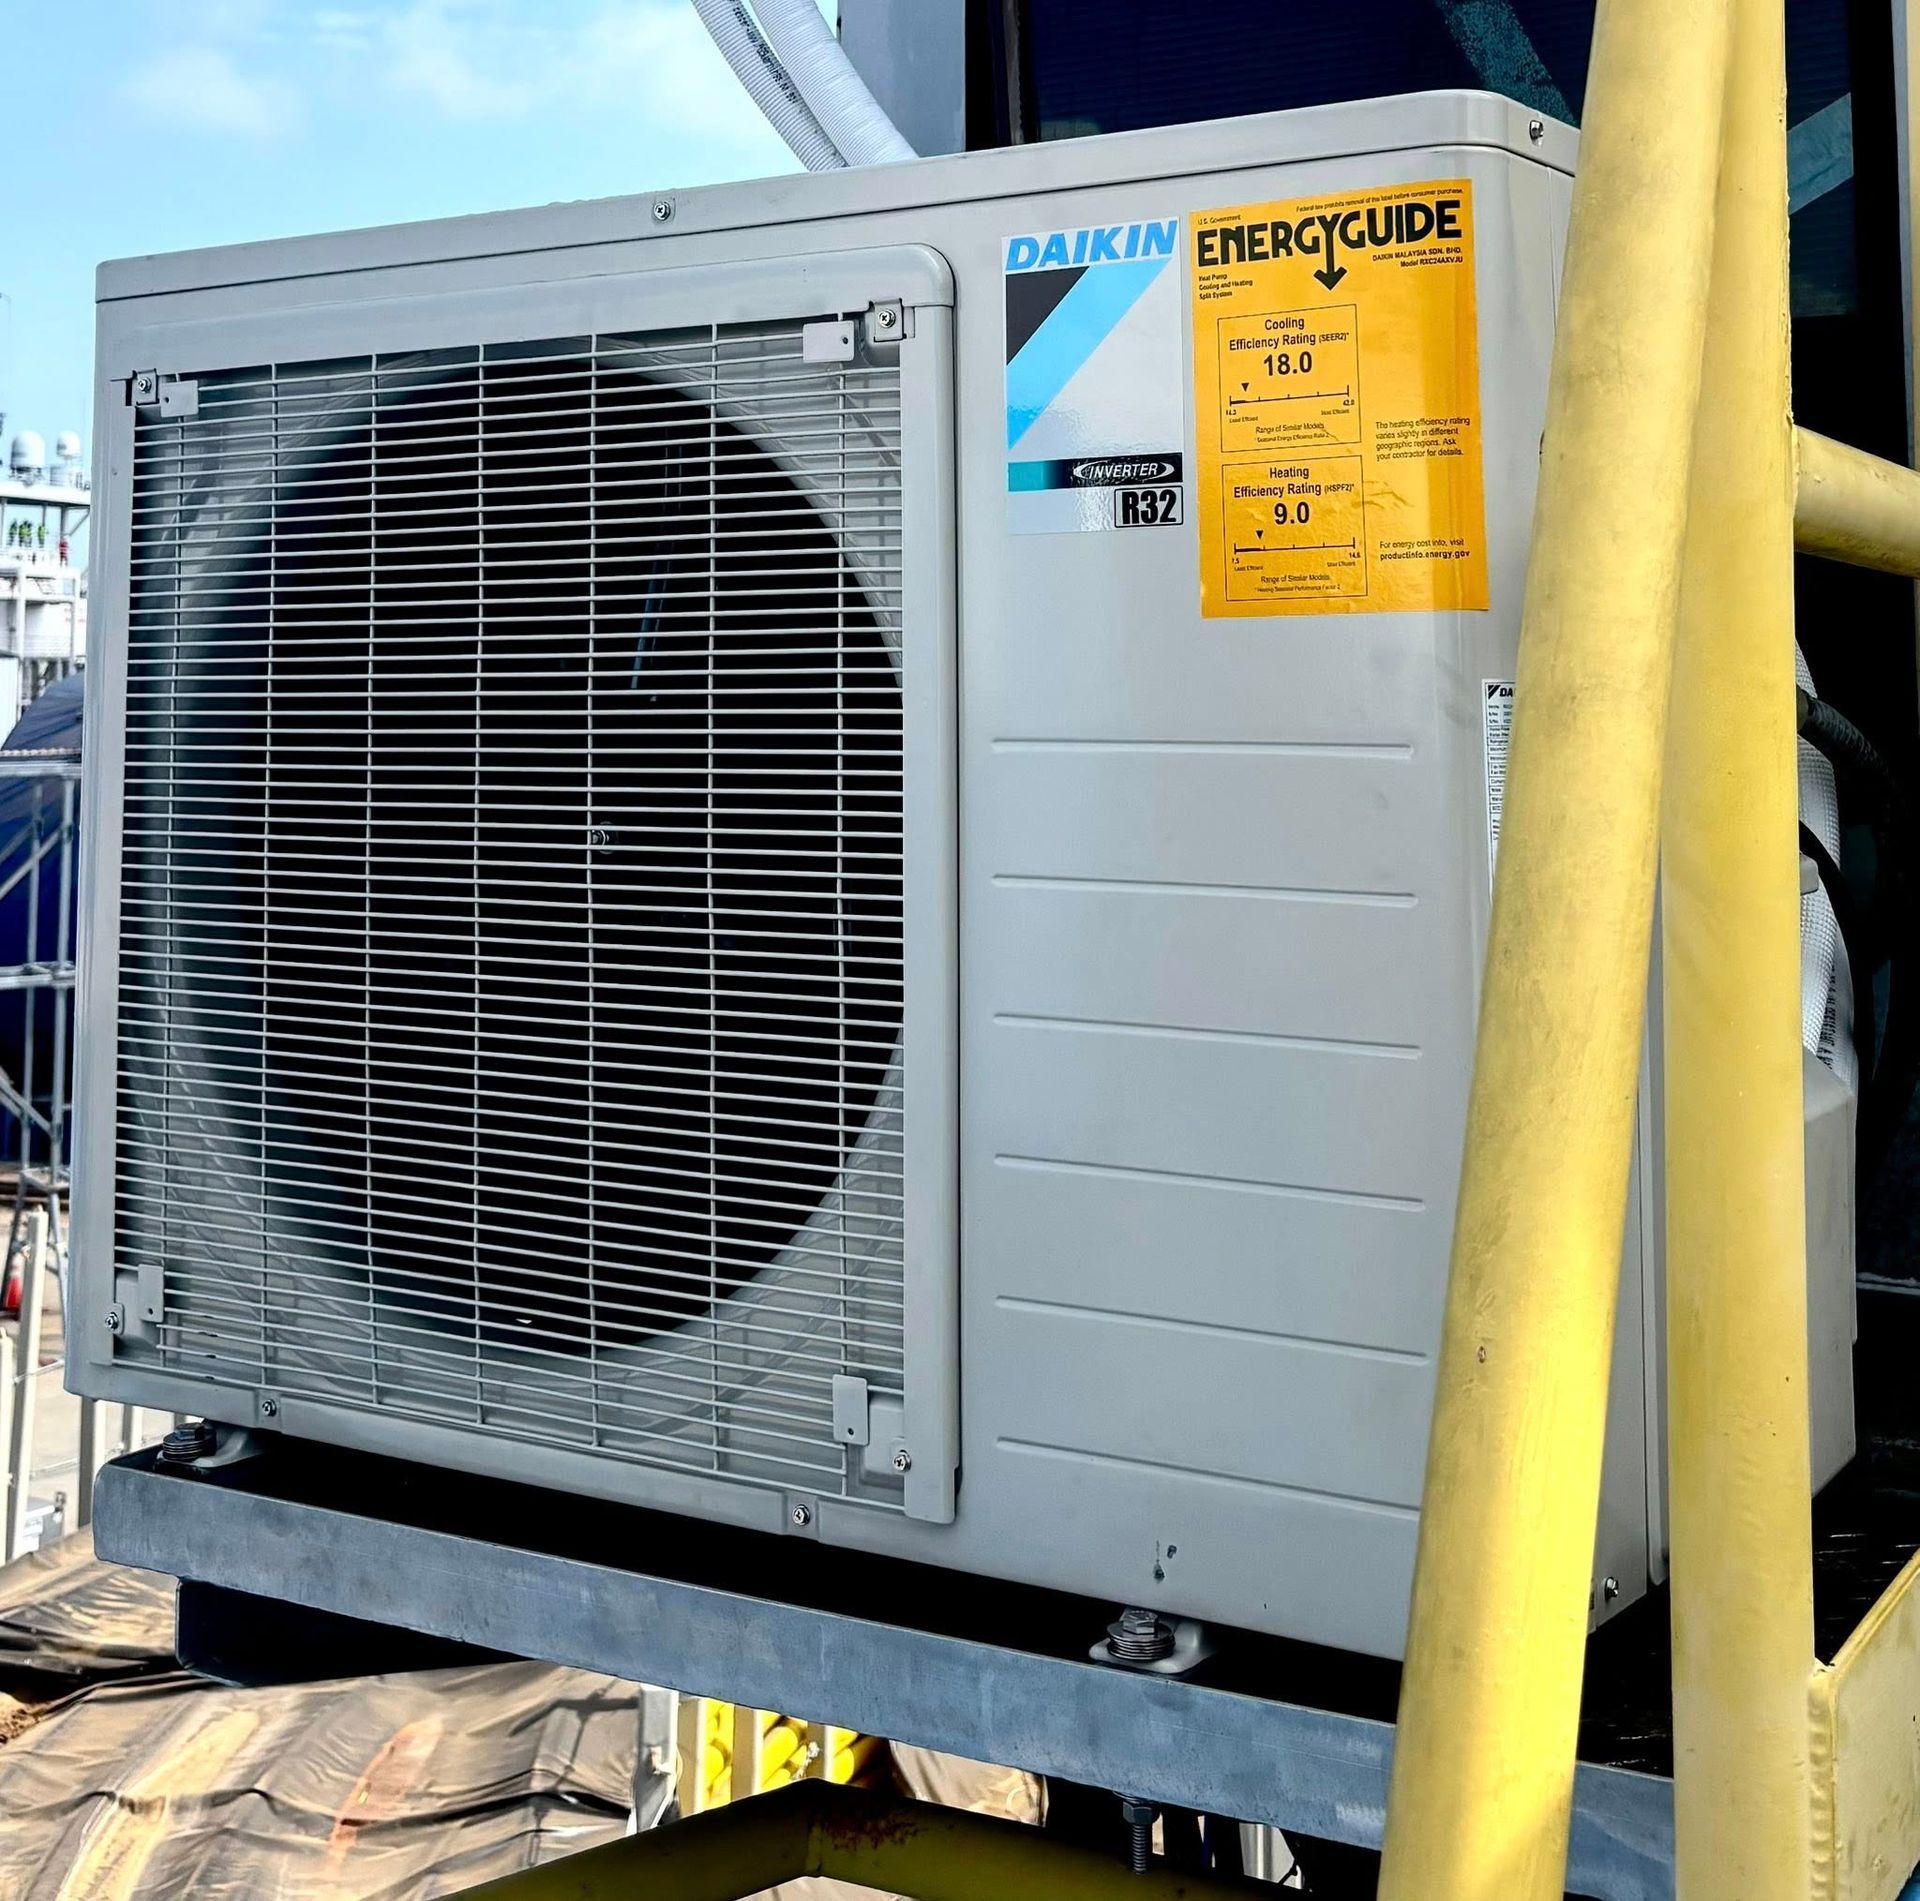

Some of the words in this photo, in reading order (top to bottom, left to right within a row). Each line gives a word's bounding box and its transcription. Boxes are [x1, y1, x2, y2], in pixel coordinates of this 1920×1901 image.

[1006, 219, 1178, 271] DAIKIN
[1372, 252, 1394, 261] DAIKIN
[1394, 249, 1428, 259] MALAYSIA
[1428, 247, 1444, 255] SDN.
[1400, 258, 1418, 267] Model
[1264, 317, 1305, 331] Cooling
[1229, 337, 1279, 351] Efficiency
[1282, 333, 1316, 346] Rating
[1263, 351, 1313, 376] 18.0
[1255, 426, 1274, 434] Range
[1375, 421, 1388, 429] The
[1389, 420, 1414, 430] heating
[1415, 418, 1448, 427] efficiency
[1449, 417, 1471, 426] rating
[1375, 432, 1395, 440] varies
[1397, 429, 1420, 439] slightly
[1421, 429, 1428, 437] in
[1428, 427, 1459, 436] different
[1376, 440, 1413, 452] geographic
[1413, 438, 1441, 448] regions.
[1442, 437, 1457, 446] Ask
[1376, 453, 1391, 462] your
[1392, 450, 1426, 459] contractor
[1426, 449, 1436, 457] for
[1437, 448, 1464, 456] details.
[1089, 462, 1158, 480] INVERTER
[1269, 467, 1309, 479] Heating
[1234, 485, 1284, 498] Efficiency
[1287, 482, 1321, 496] Rating
[1121, 489, 1177, 525] R32
[1274, 501, 1310, 525] 9.0
[1379, 541, 1391, 549] For
[1392, 540, 1415, 549] energy
[1416, 539, 1431, 547] cost
[1450, 538, 1464, 546] visit
[1380, 550, 1470, 561] productinfo.energy.gov
[1260, 576, 1279, 584] Range
